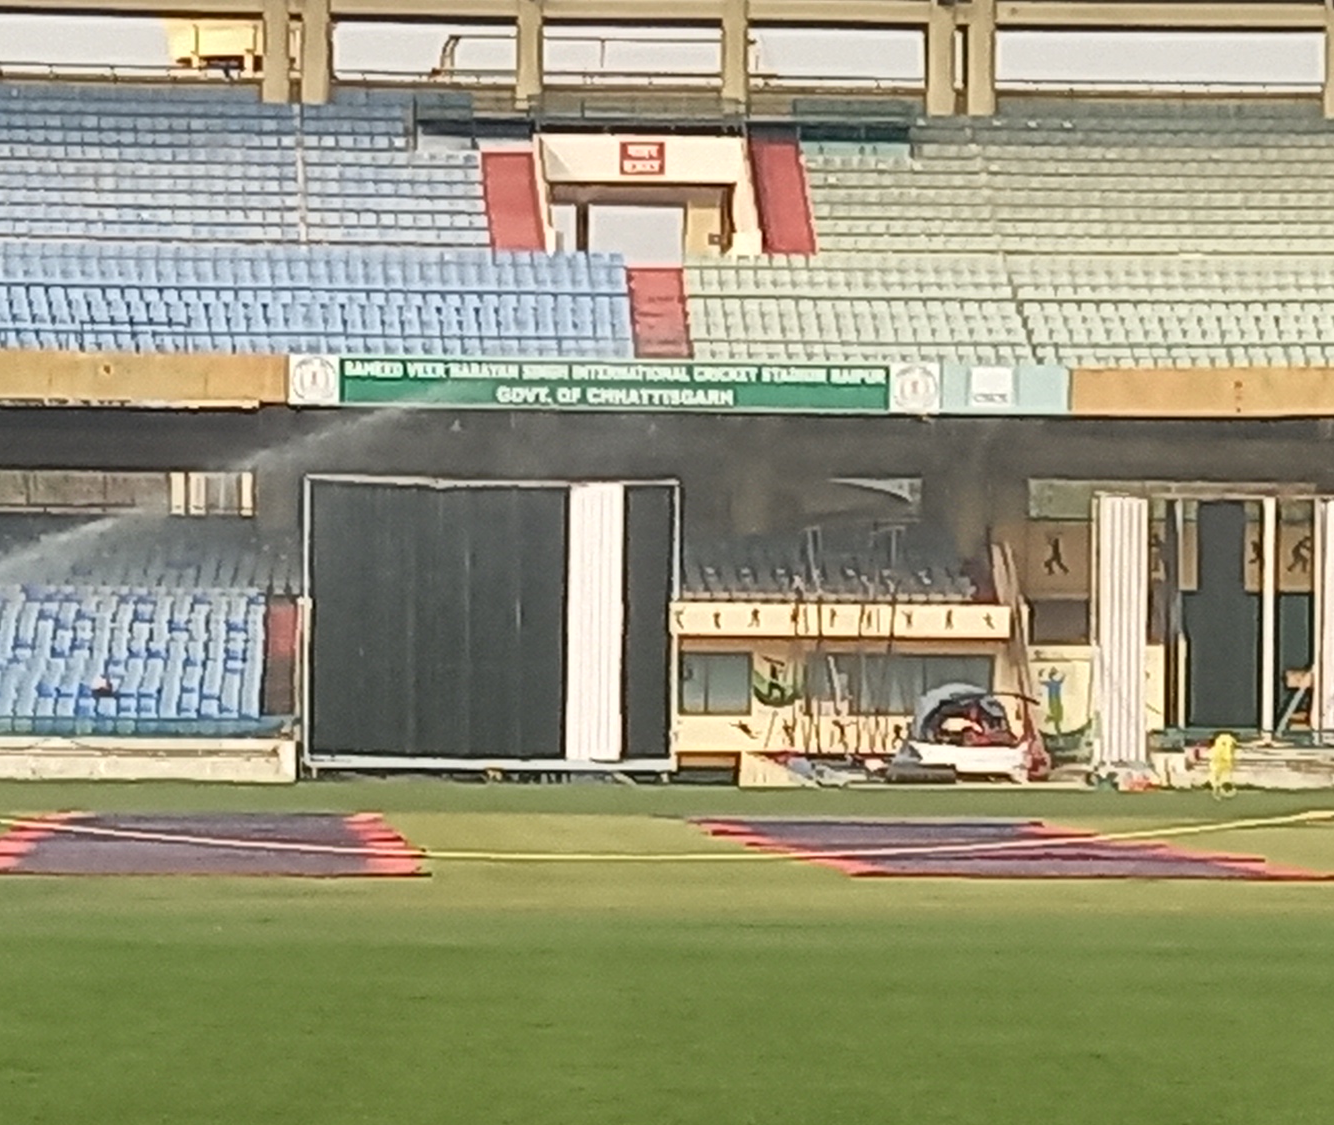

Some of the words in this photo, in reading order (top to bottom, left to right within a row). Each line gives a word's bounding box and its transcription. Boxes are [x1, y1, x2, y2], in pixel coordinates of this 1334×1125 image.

[571, 364, 690, 382] INTERNATIONAL
[692, 366, 759, 383] CRICKET
[760, 367, 828, 383] STADIUM
[495, 385, 553, 404] GOVT.
[555, 386, 582, 404] OF
